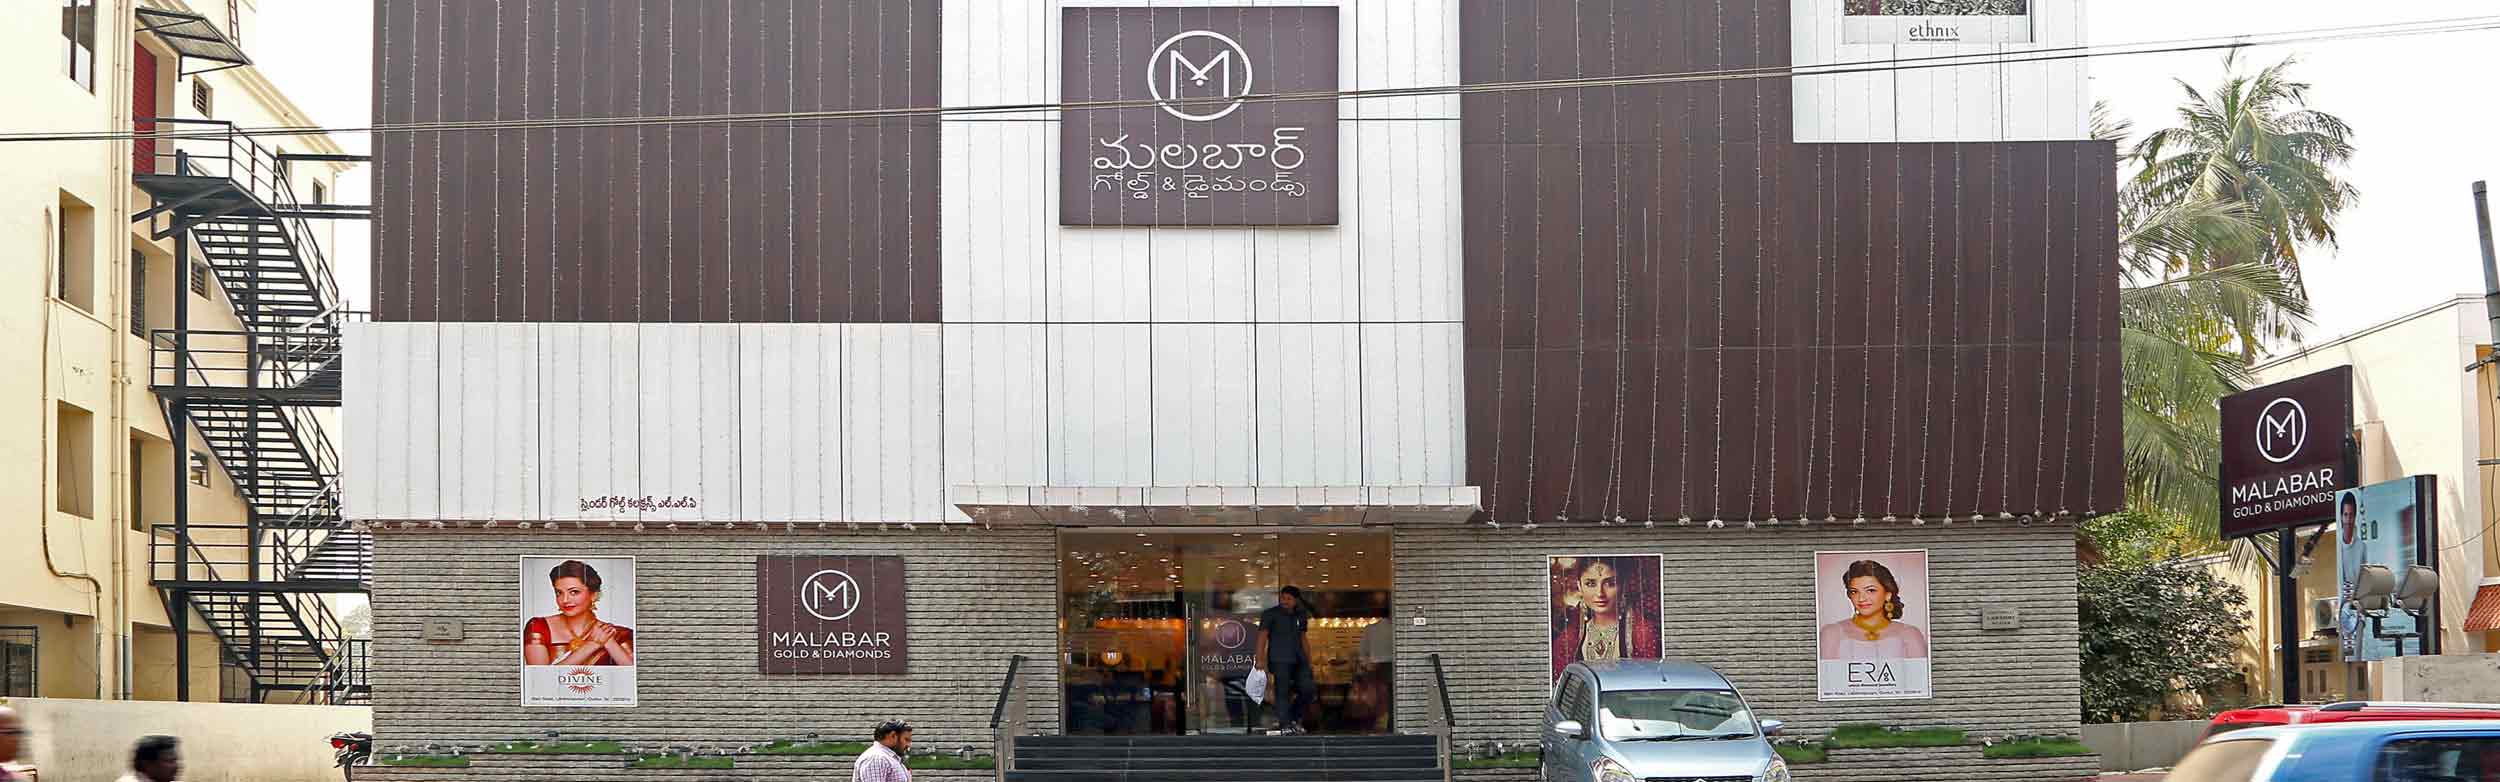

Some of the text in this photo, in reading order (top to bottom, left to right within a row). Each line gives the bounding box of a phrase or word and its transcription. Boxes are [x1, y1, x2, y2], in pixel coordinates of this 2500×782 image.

[1909, 19, 1960, 37] ethnix
[1094, 127, 1305, 169] మలబార్
[1094, 172, 1155, 199] గోల్డ్
[1162, 177, 1177, 191] &
[2232, 468, 2335, 505] MALABAR
[2233, 490, 2335, 518] GOLD & DIAMONDS
[772, 631, 891, 647] MALABAR
[773, 649, 892, 659] GOLD & DIAMONDS
[1201, 655, 1257, 664] MALABA
[558, 675, 603, 684] DIVINE
[1848, 662, 1896, 682] ERA
